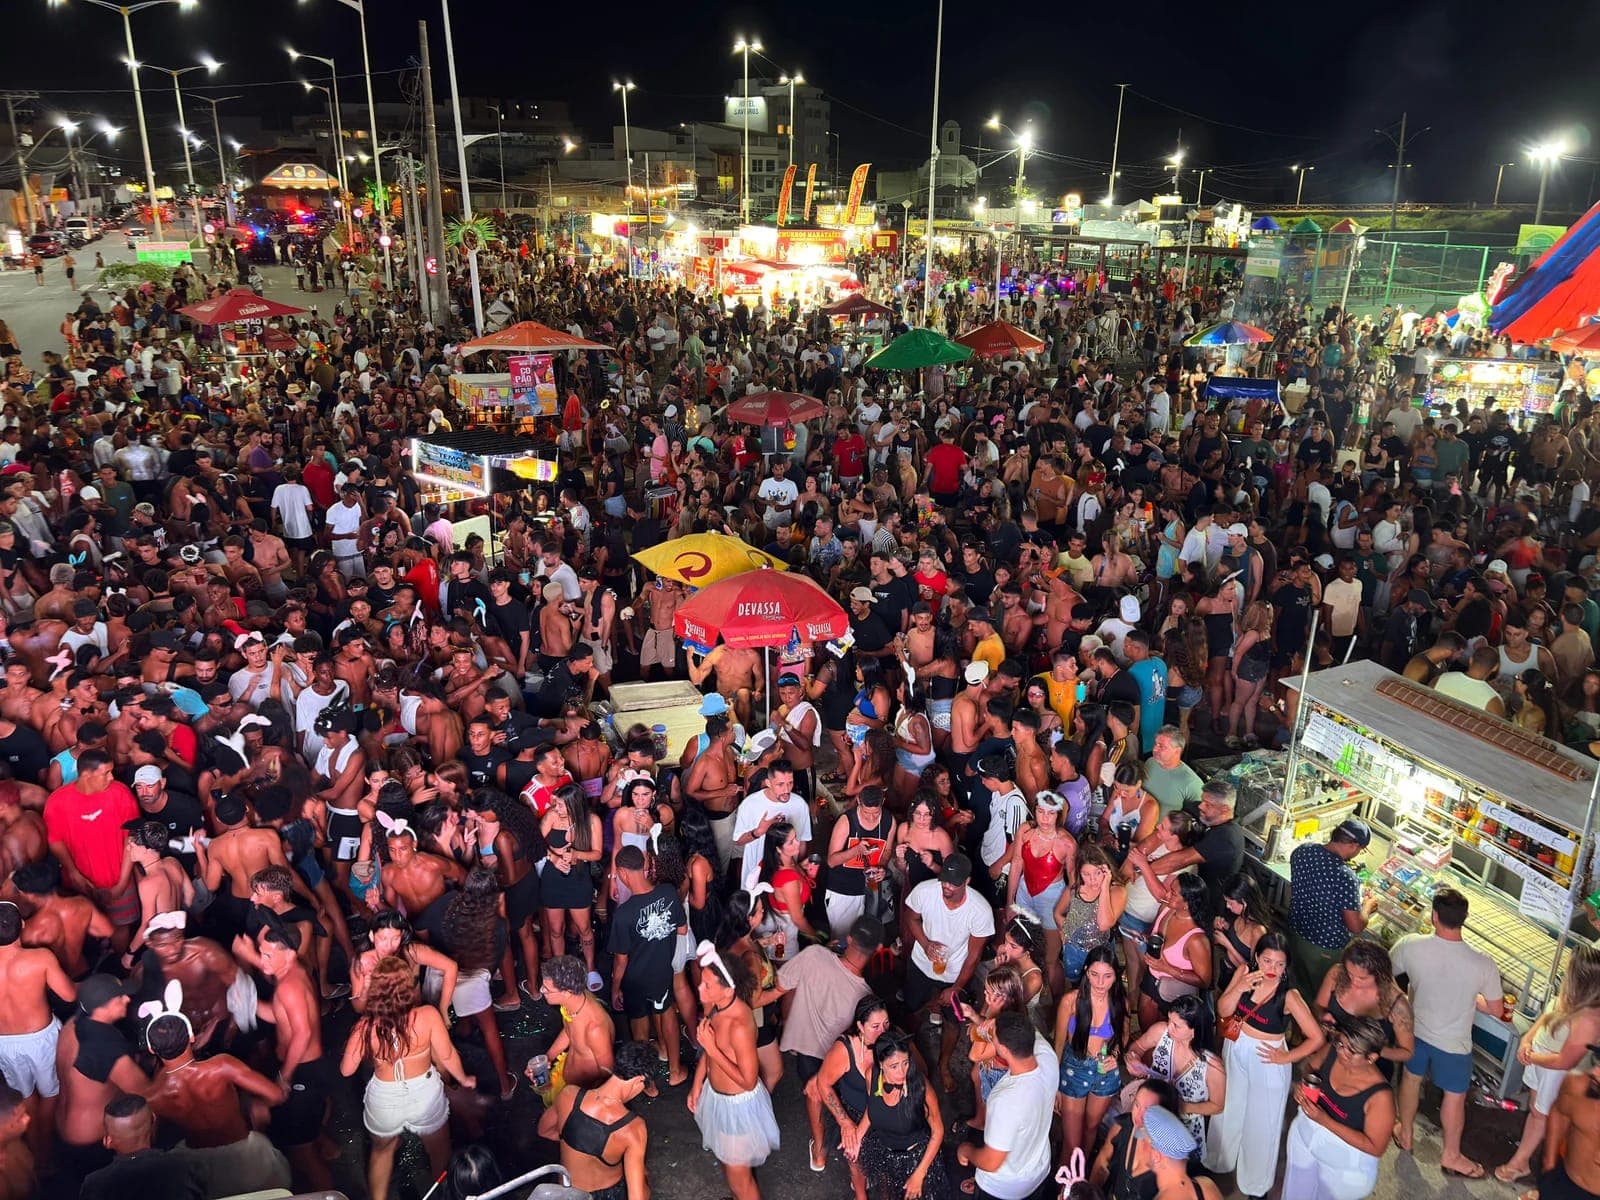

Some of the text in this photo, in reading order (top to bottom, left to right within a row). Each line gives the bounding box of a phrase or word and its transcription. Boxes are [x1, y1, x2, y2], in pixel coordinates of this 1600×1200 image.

[238, 305, 270, 316] ITAIPAVA
[520, 367, 531, 375] CO
[738, 601, 781, 617] DEVASSA
[640, 897, 665, 923] NIKE
